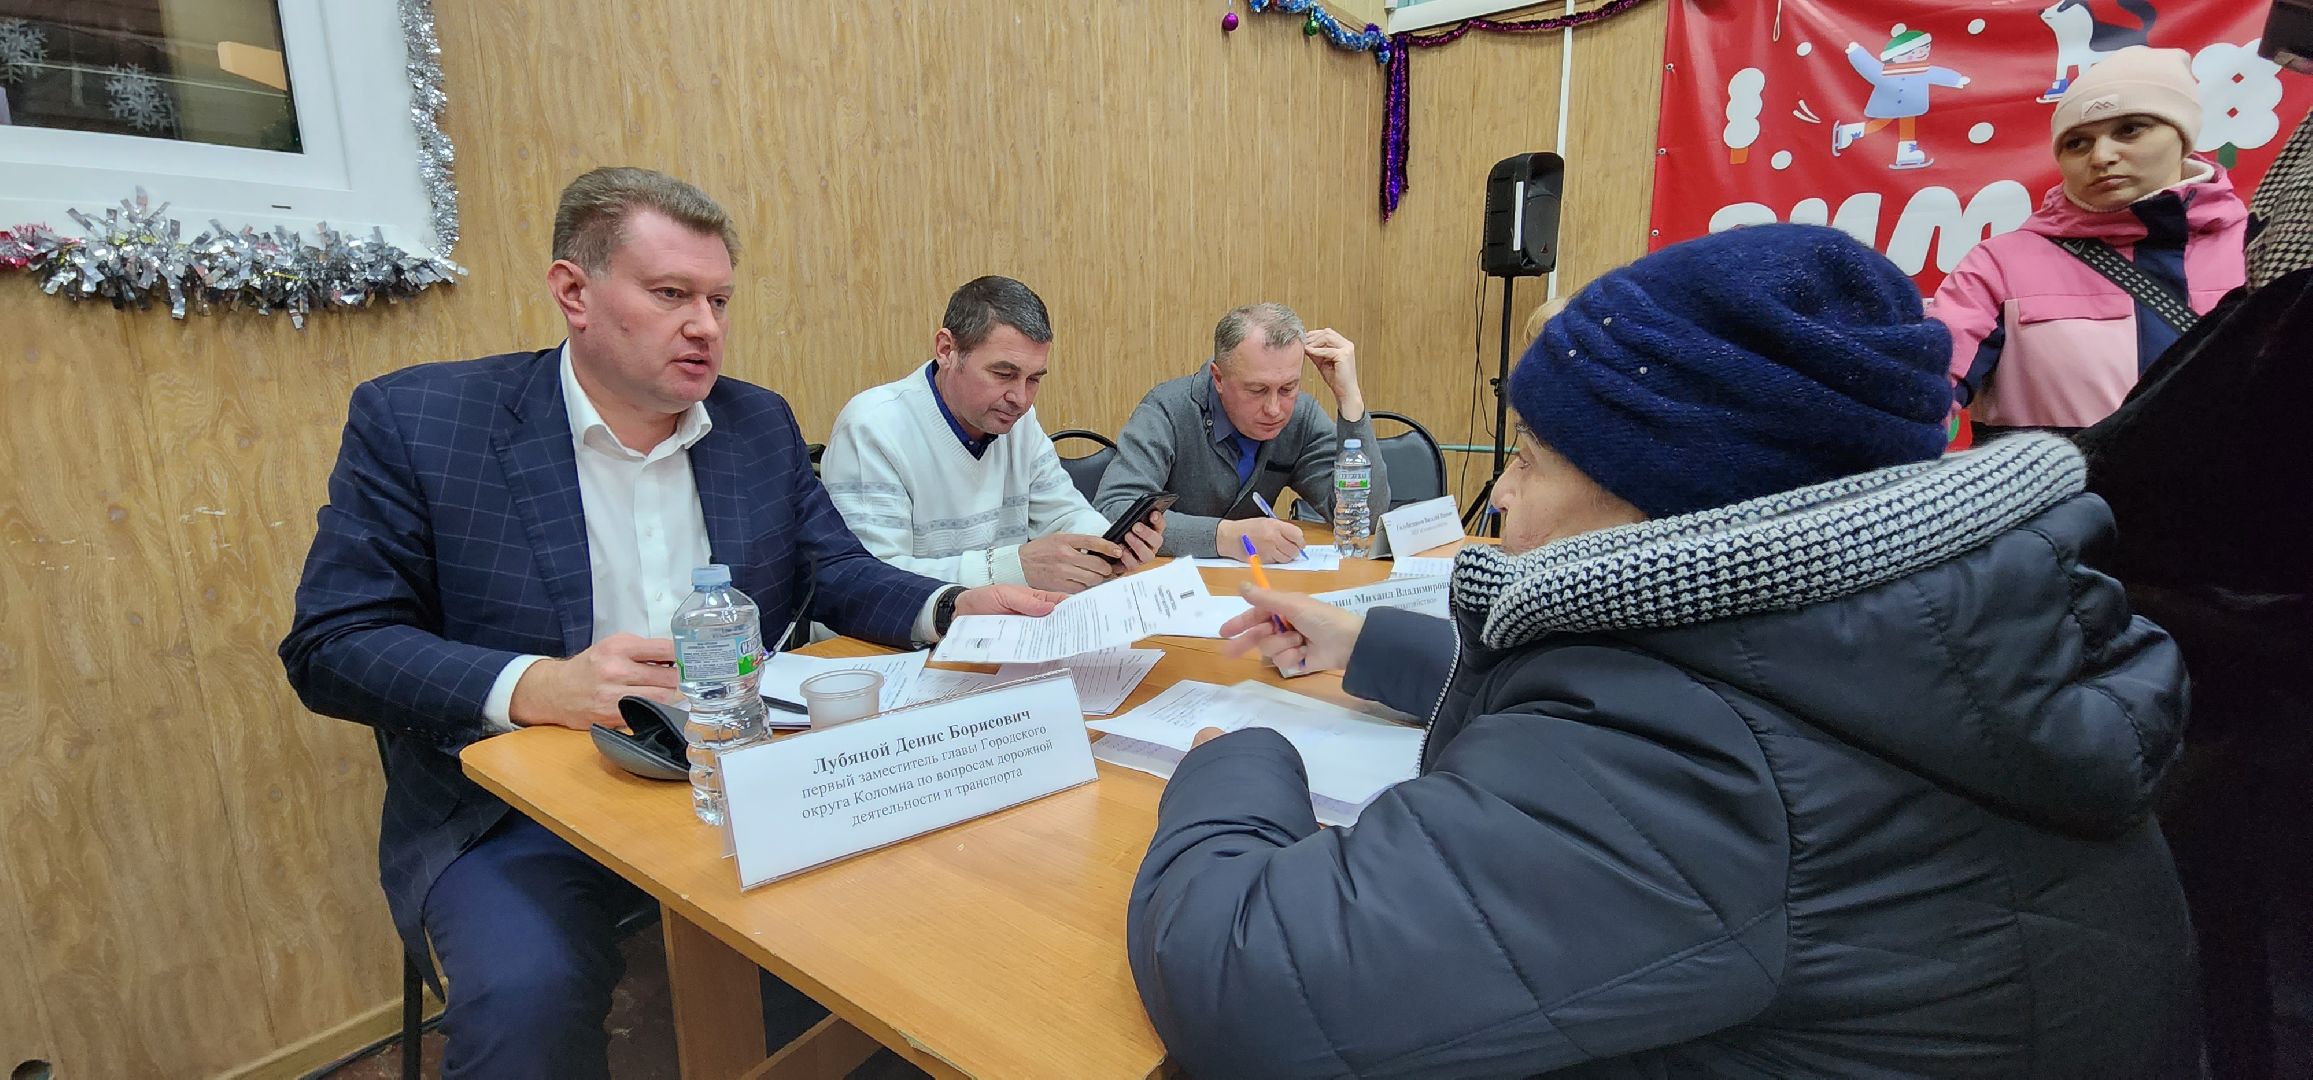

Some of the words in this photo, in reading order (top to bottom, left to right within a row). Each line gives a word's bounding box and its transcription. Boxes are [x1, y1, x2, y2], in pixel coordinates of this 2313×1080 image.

[801, 773, 856, 799] первый
[857, 753, 940, 784] заместитель
[941, 743, 979, 762] главы
[979, 724, 1047, 751] Городского
[812, 741, 891, 775] Лубяной
[895, 730, 946, 756] Денис
[948, 709, 1032, 739] Борисович
[801, 797, 852, 820] округа
[853, 779, 915, 805] Коломна
[916, 774, 934, 788] по
[936, 757, 995, 782] вопросам
[996, 738, 1054, 767] дорожной
[850, 790, 942, 828] деятельности
[943, 788, 953, 799] и
[954, 767, 1024, 797] транспорта
